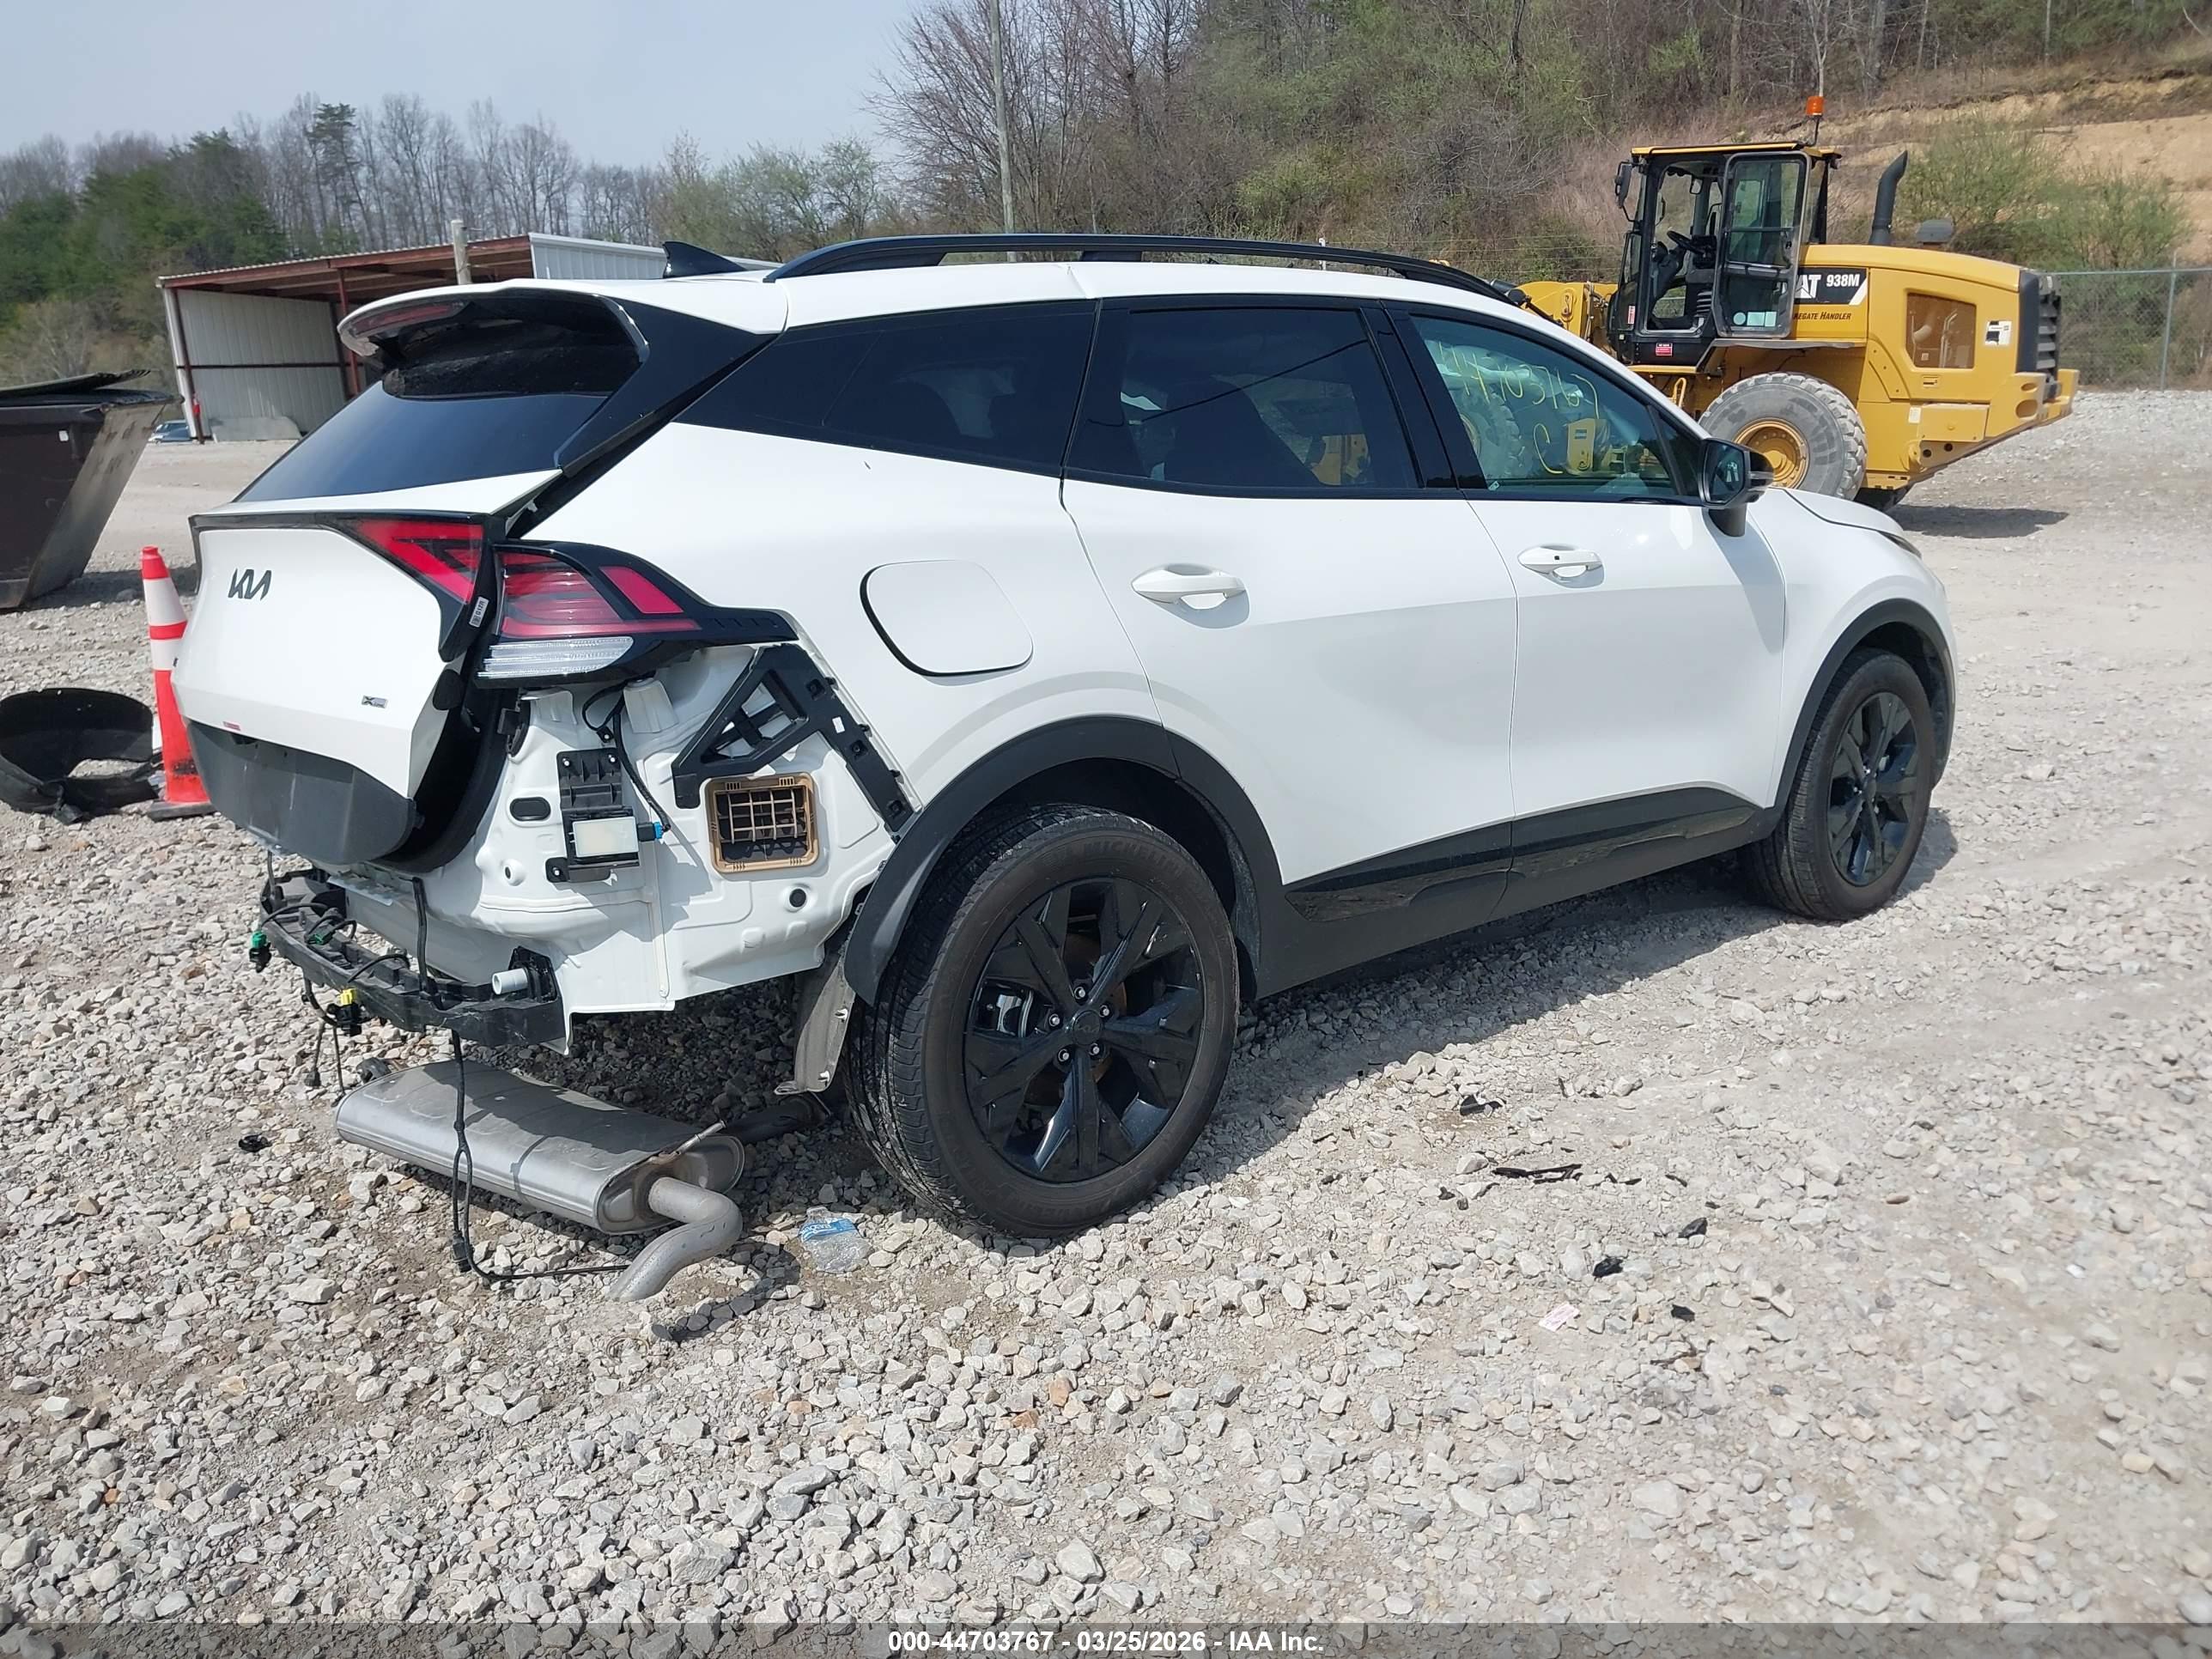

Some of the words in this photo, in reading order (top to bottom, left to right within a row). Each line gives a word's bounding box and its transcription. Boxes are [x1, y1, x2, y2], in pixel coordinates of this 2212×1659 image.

[1795, 274, 1821, 299] AT
[1826, 274, 1861, 287] 938M
[228, 568, 272, 601] KIA
